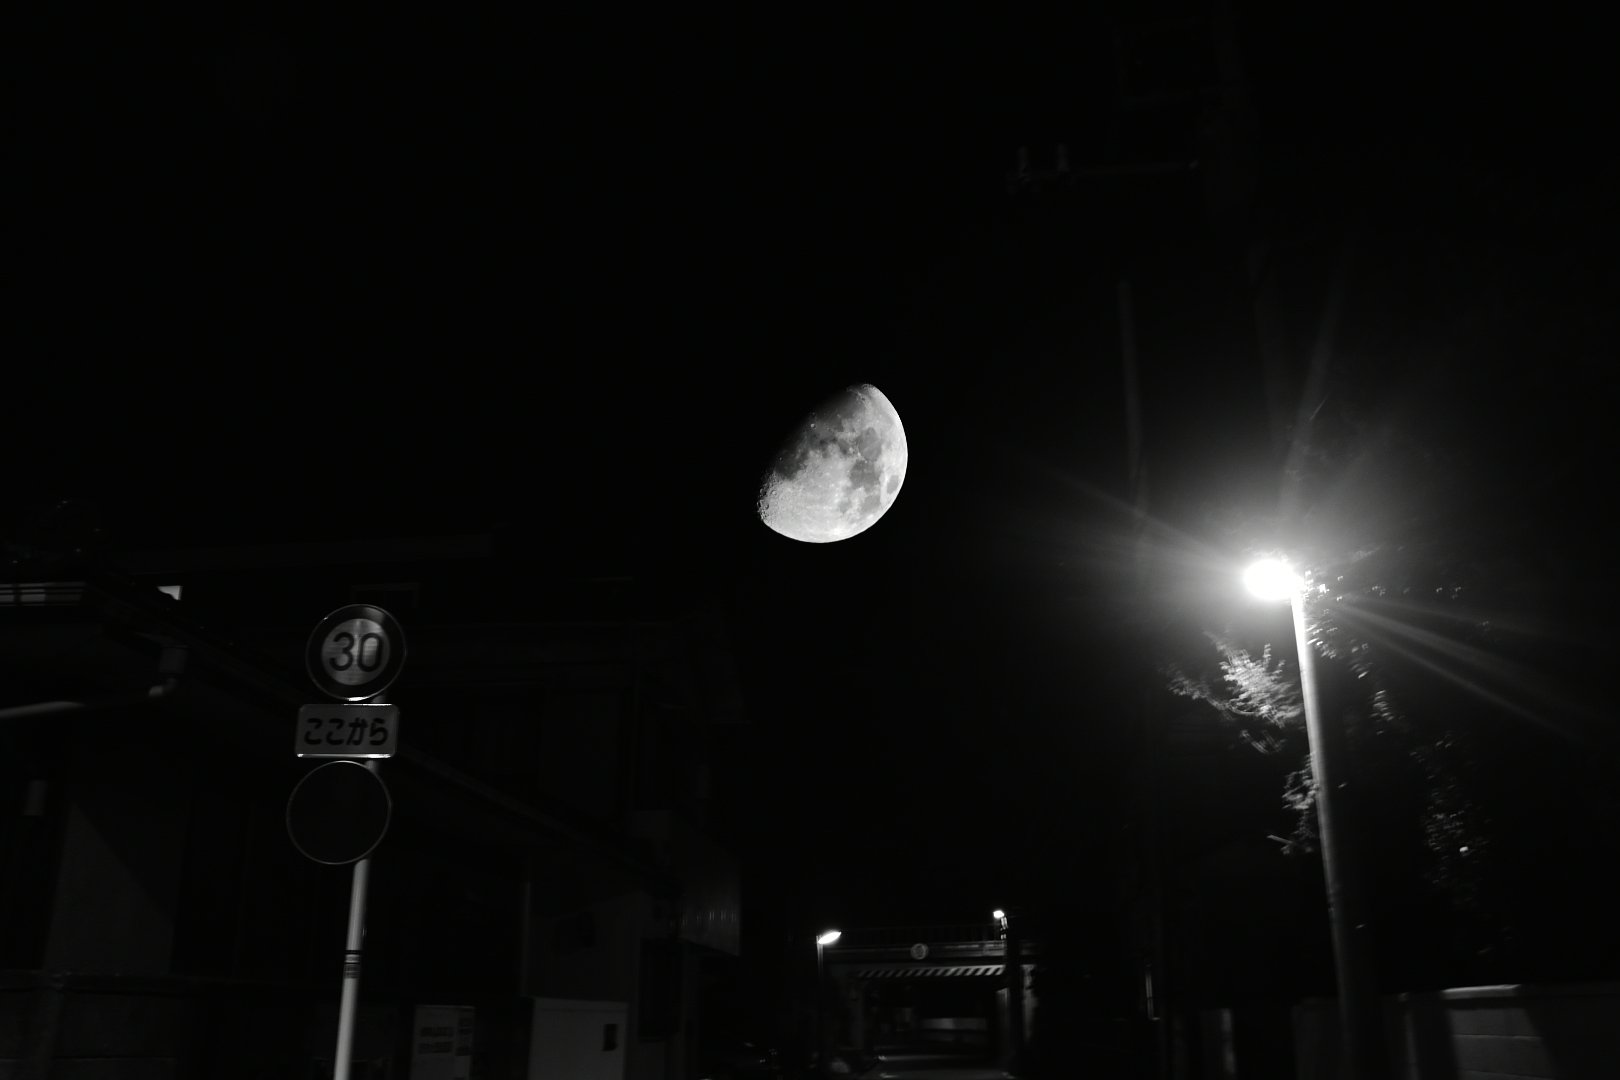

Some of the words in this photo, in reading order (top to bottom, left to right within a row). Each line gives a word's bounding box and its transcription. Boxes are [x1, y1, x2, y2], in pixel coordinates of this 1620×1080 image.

[329, 632, 383, 672] 30
[304, 717, 389, 746] ここから
